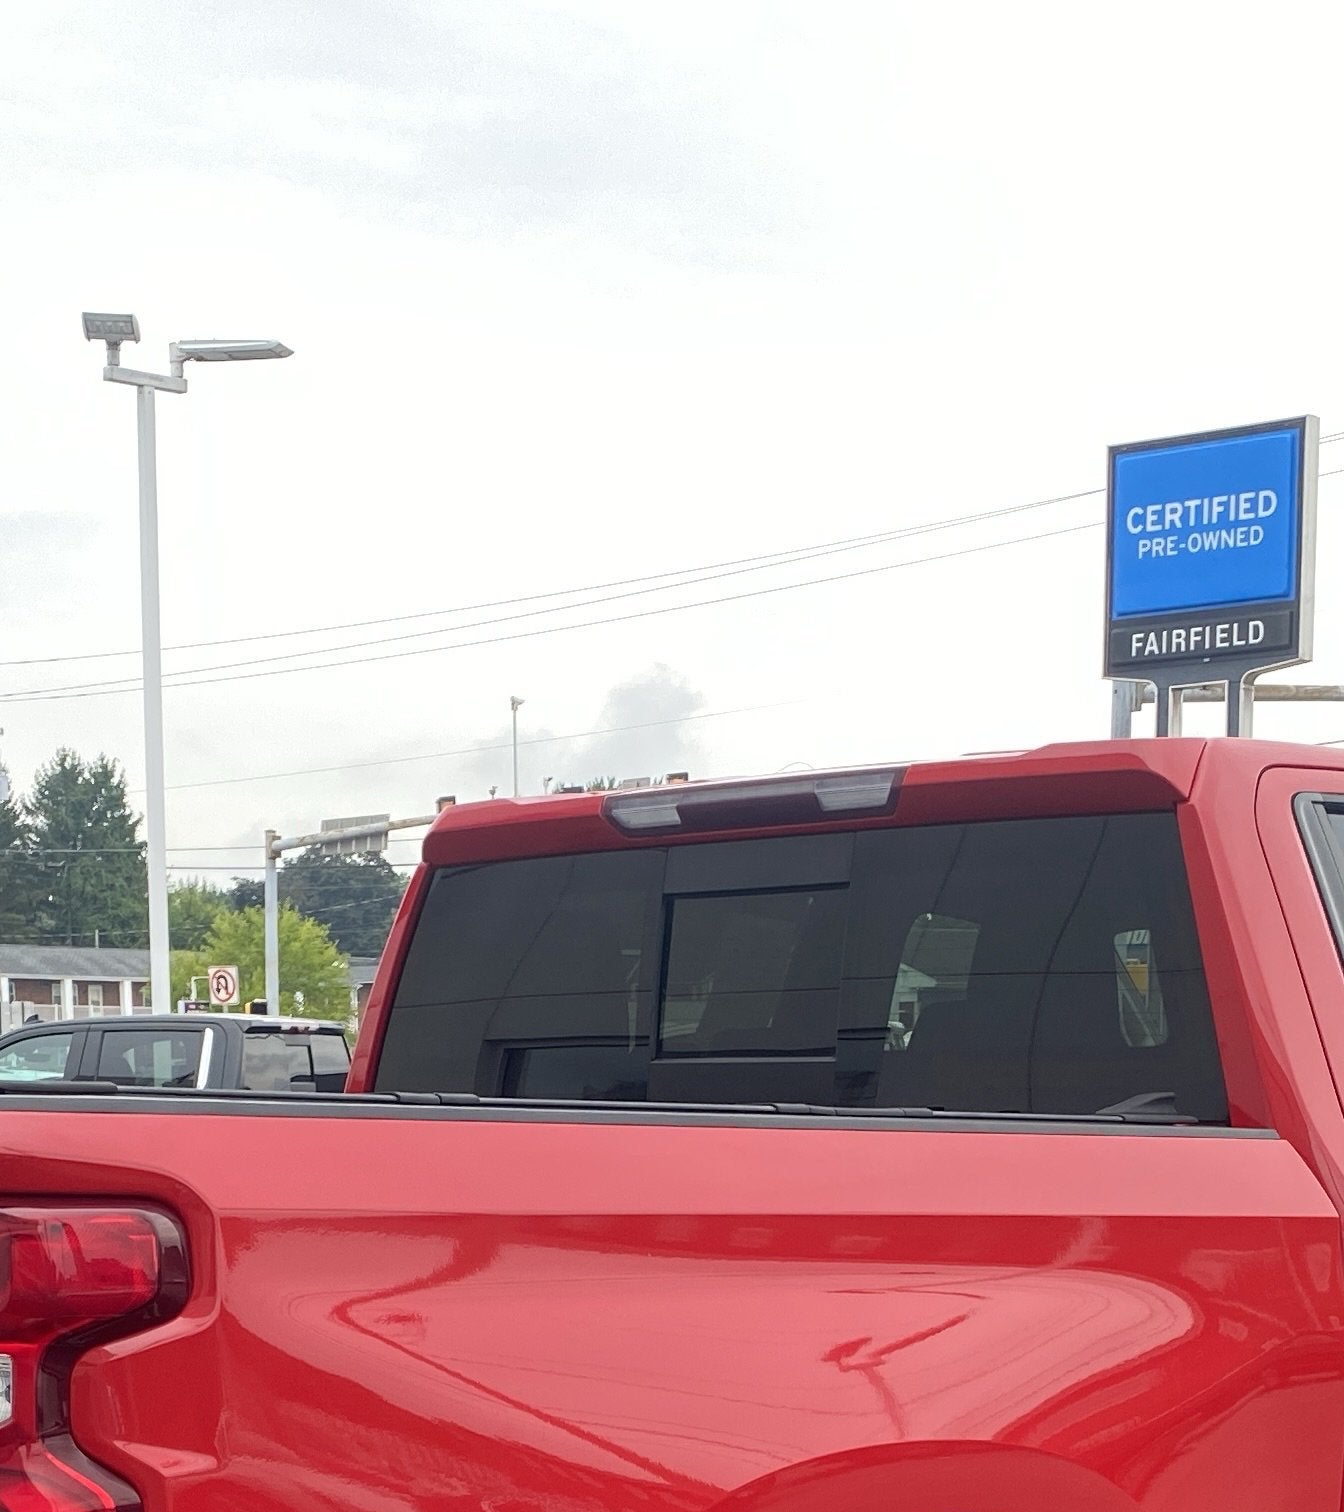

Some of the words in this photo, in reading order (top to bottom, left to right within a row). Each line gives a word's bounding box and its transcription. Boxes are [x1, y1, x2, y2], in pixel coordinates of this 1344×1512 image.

[1126, 489, 1278, 535] CERTIFIED
[1138, 525, 1264, 560] PRE-OWNED
[1131, 620, 1265, 657] FAIRFIELD
